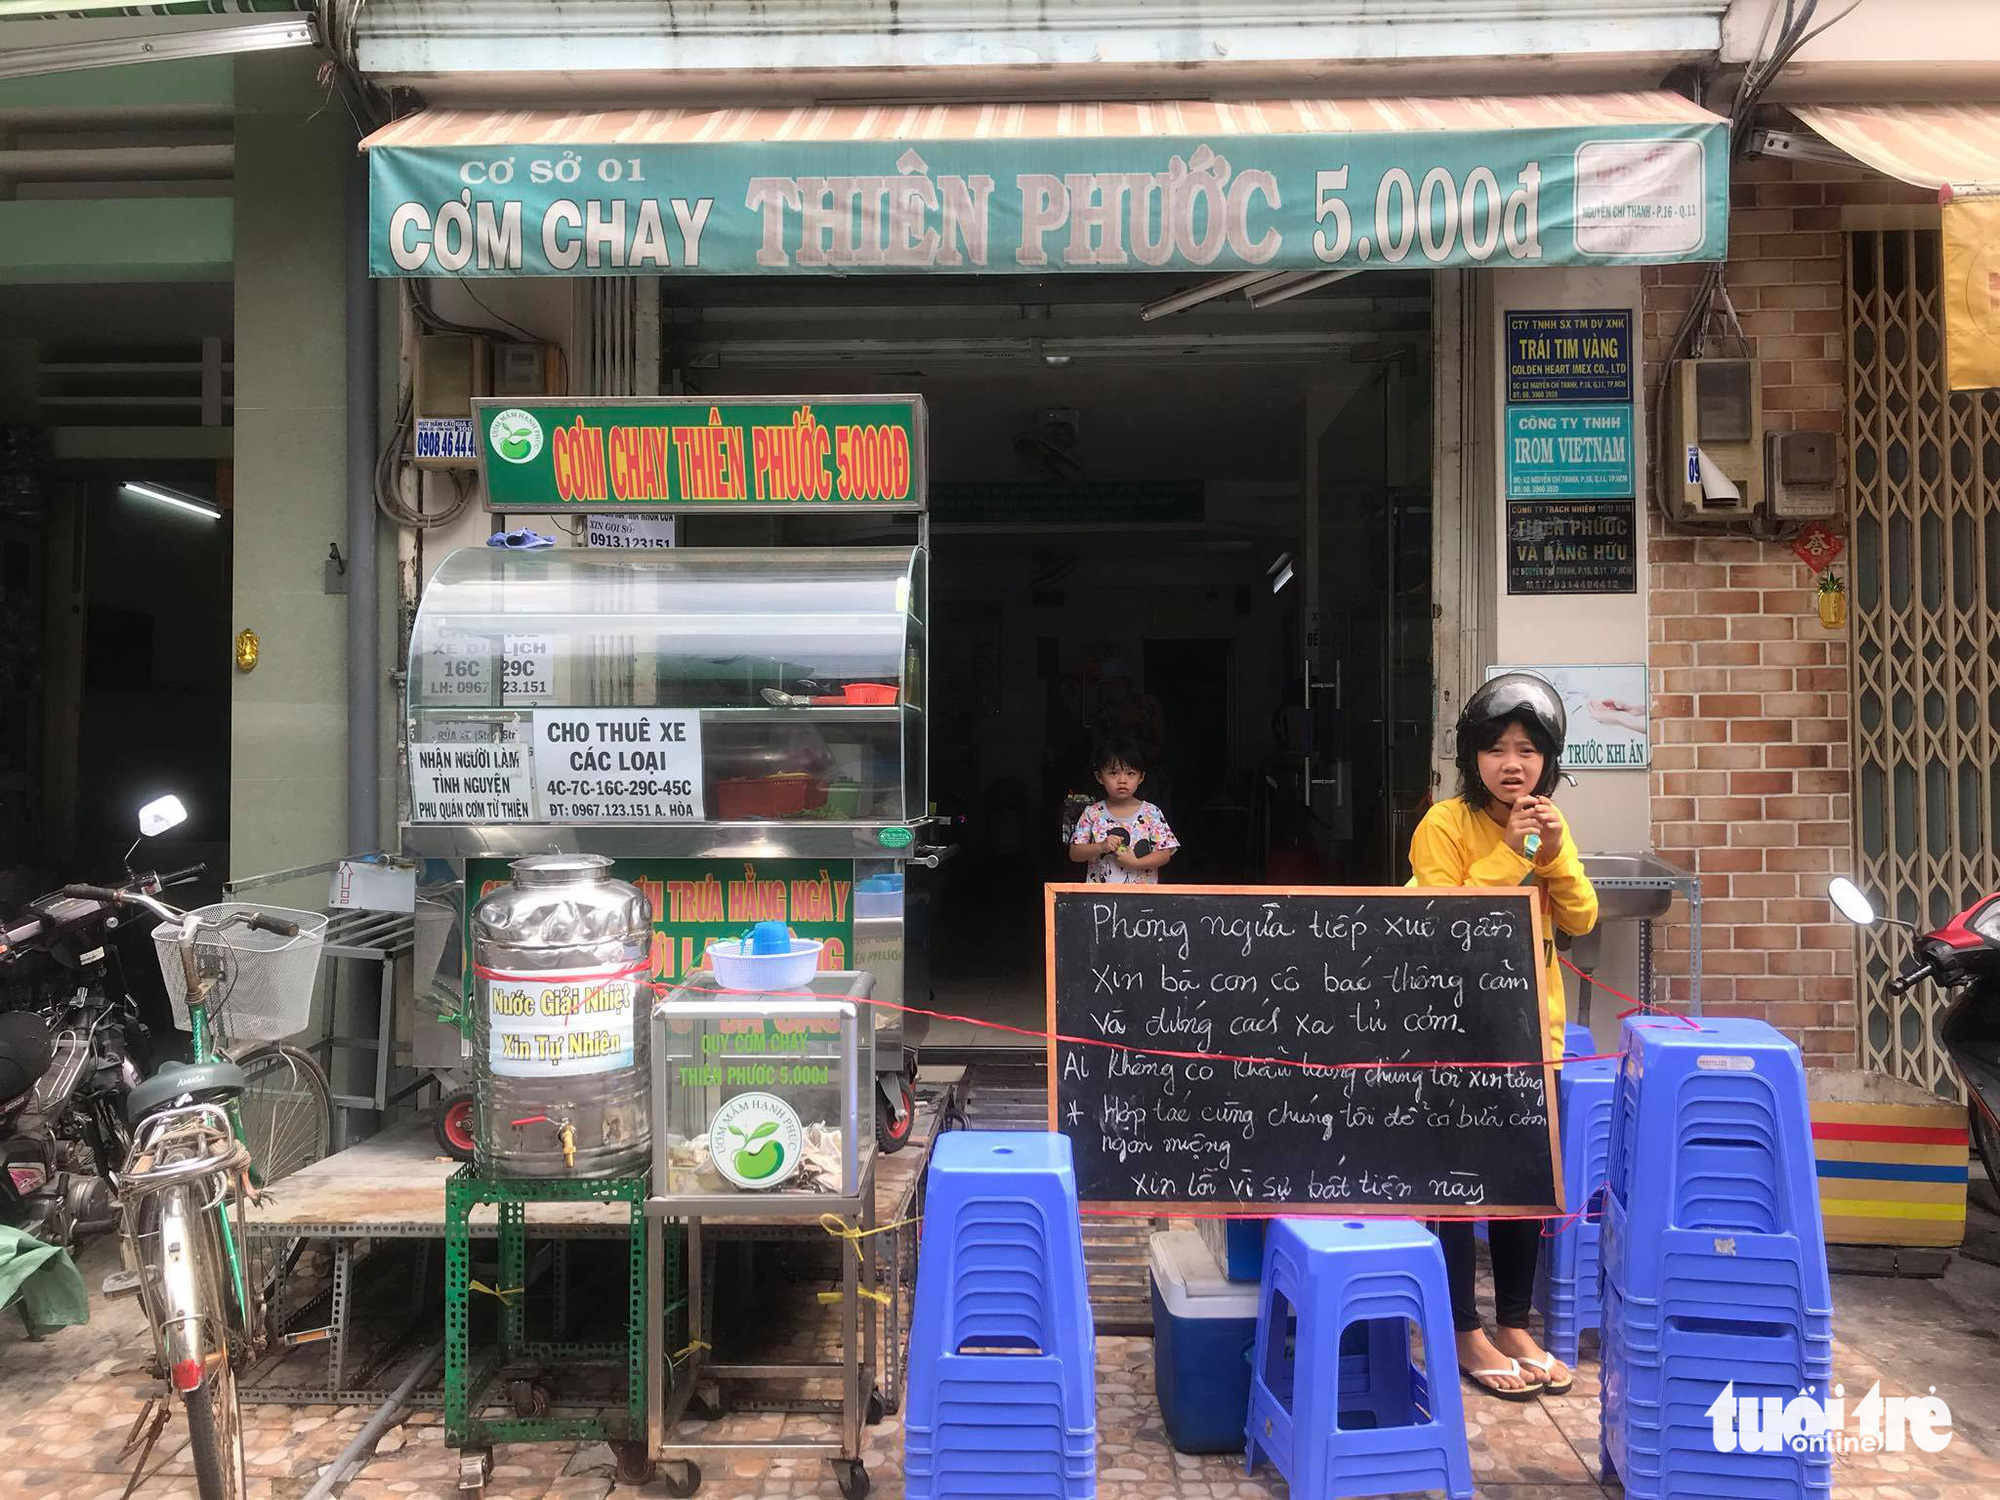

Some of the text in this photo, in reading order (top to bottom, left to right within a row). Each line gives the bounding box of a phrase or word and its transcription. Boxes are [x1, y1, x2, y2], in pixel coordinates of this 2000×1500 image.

[460, 150, 646, 184] CƠ SỞ 01
[388, 143, 1544, 271] CƠM CHAY THIÊN PHƯỚC 5.000đ
[1511, 320, 1529, 330] CTY
[1532, 320, 1557, 330] TNHH
[1559, 319, 1572, 329] SX
[1575, 319, 1588, 329] TM
[1605, 318, 1625, 328] XNK
[1520, 333, 1618, 360] TRÁI TIM VÀNG
[1511, 365, 1543, 375] GOLDEN
[1545, 364, 1570, 374] HEART
[1572, 364, 1592, 374] IMEX
[1611, 363, 1626, 374] LTD
[1519, 415, 1621, 430] CÔNG TY TNHH
[552, 415, 605, 502] CƠM
[610, 426, 670, 501] CHAY
[673, 406, 748, 501] THIÊN
[752, 405, 833, 501] PHƯỚC
[836, 425, 911, 500] 5000Đ
[1515, 436, 1626, 464] IROM VIETNAM
[589, 520, 603, 530] XIN
[605, 521, 620, 533] GỌI
[444, 660, 480, 677] 16C
[431, 682, 452, 694] LH:
[547, 717, 686, 742] CHO THUÊ XE
[420, 747, 520, 772] NHẬN NGƯỜI LÀM
[570, 746, 666, 775] CÁC LOẠI
[1567, 738, 1644, 764] TRƯỚC KHI ĂN
[432, 772, 511, 796] TÌNH NGUYỆN
[547, 780, 692, 796] 4C-7C-16C-29C-45C
[418, 798, 529, 820] PHỤ QUÁN CƠM TỪ THIỆN
[550, 801, 694, 816] ĐT: 0967.123.151 A. HÒA
[668, 875, 724, 922] TRƯA
[1210, 973, 1257, 993] con
[1270, 966, 1300, 992] cô
[1383, 962, 1463, 1008] thông
[493, 983, 631, 1017] Nước Giải Nhiệt
[502, 1030, 621, 1066] Xin Tự Nhiên
[1064, 1045, 1090, 1081] Ai
[176, 1075, 206, 1088] AMASA
[1340, 1103, 1375, 1128] tôi
